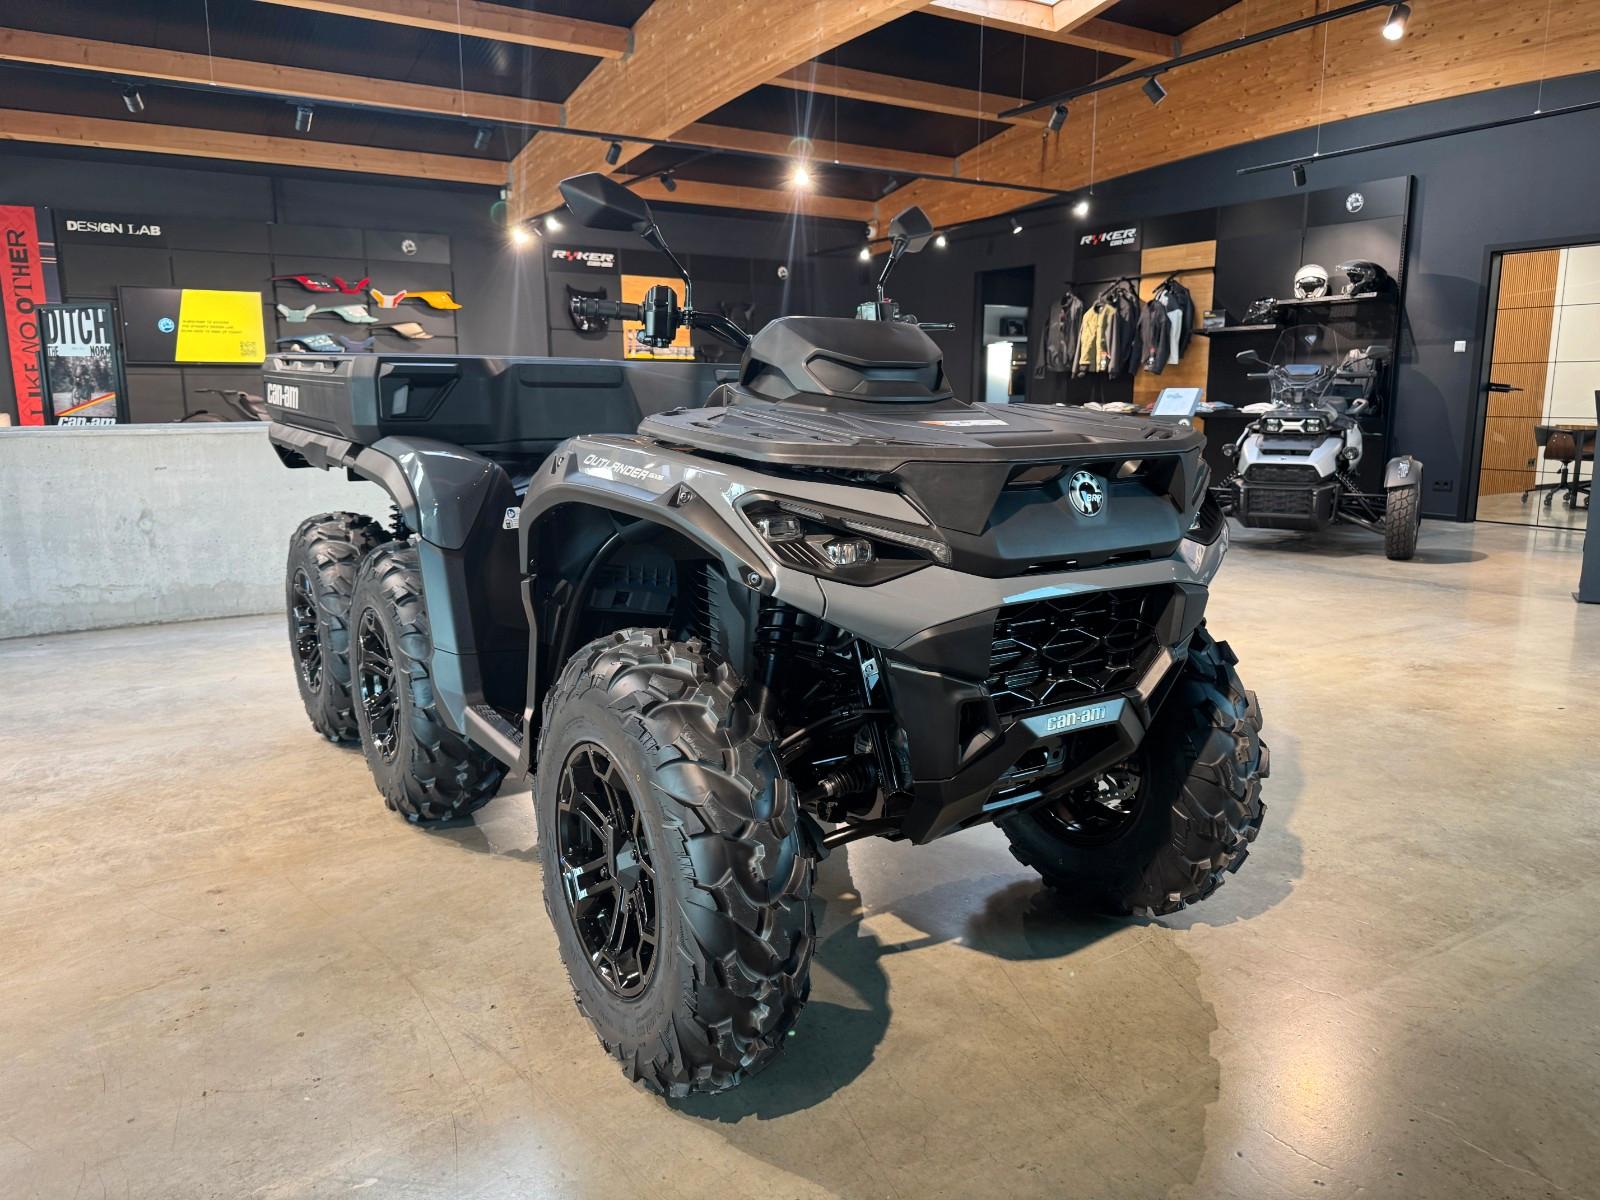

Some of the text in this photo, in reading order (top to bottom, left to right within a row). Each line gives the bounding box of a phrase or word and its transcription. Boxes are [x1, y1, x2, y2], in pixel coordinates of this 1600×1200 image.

[66, 220, 162, 236] DESIGN LAB
[1080, 228, 1137, 246] RYKER
[551, 249, 615, 262] RYKER
[6, 229, 35, 315] OTHER
[46, 309, 107, 344] DITCH
[48, 345, 111, 358] THE NORM
[267, 382, 299, 410] can-am
[583, 453, 650, 480] OUTLANDER
[1047, 706, 1107, 731] can-am
